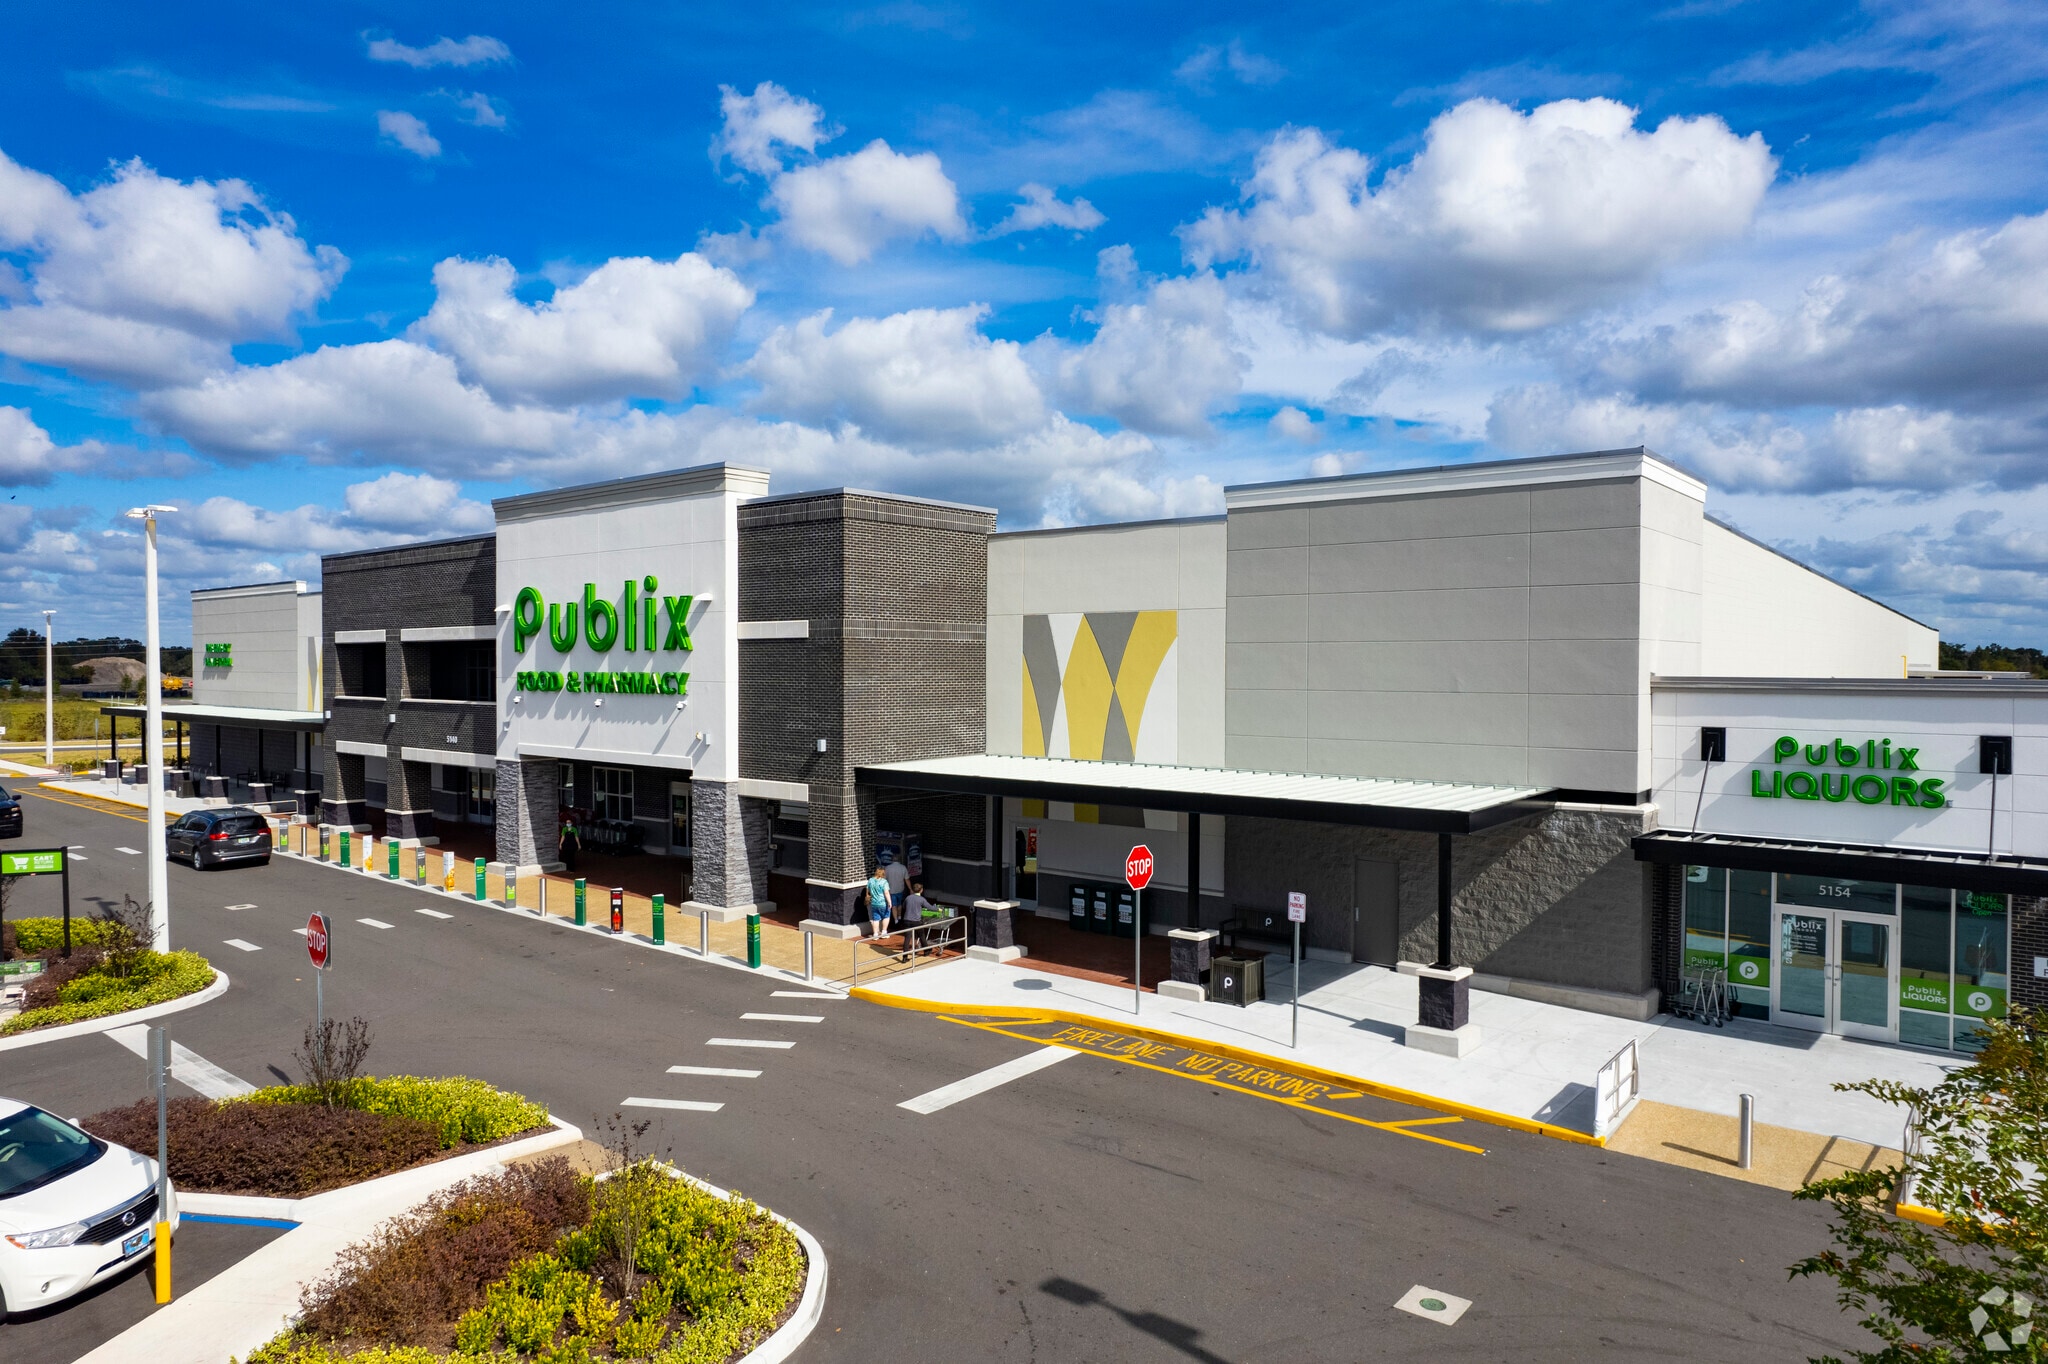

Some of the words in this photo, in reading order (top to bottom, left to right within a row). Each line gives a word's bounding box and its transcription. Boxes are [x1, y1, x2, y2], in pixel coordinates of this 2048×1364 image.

[513, 575, 694, 653] Publix
[516, 671, 565, 692] FOOD
[566, 672, 582, 693] &
[583, 671, 690, 695] PHARMACY
[1774, 735, 1920, 771] Publix
[1751, 769, 1946, 809] LIQUORS
[1127, 858, 1152, 878] STOP
[1818, 884, 1852, 898] 5154
[308, 929, 326, 953] STOP
[1691, 956, 1719, 966] Publix
[1902, 991, 1947, 1005] LIQUORS
[1908, 984, 1942, 996] Publix
[1052, 1026, 1115, 1046] FIRE
[1102, 1037, 1176, 1060] LANE
[1176, 1054, 1223, 1072] NO
[1212, 1063, 1330, 1099] PARKING
